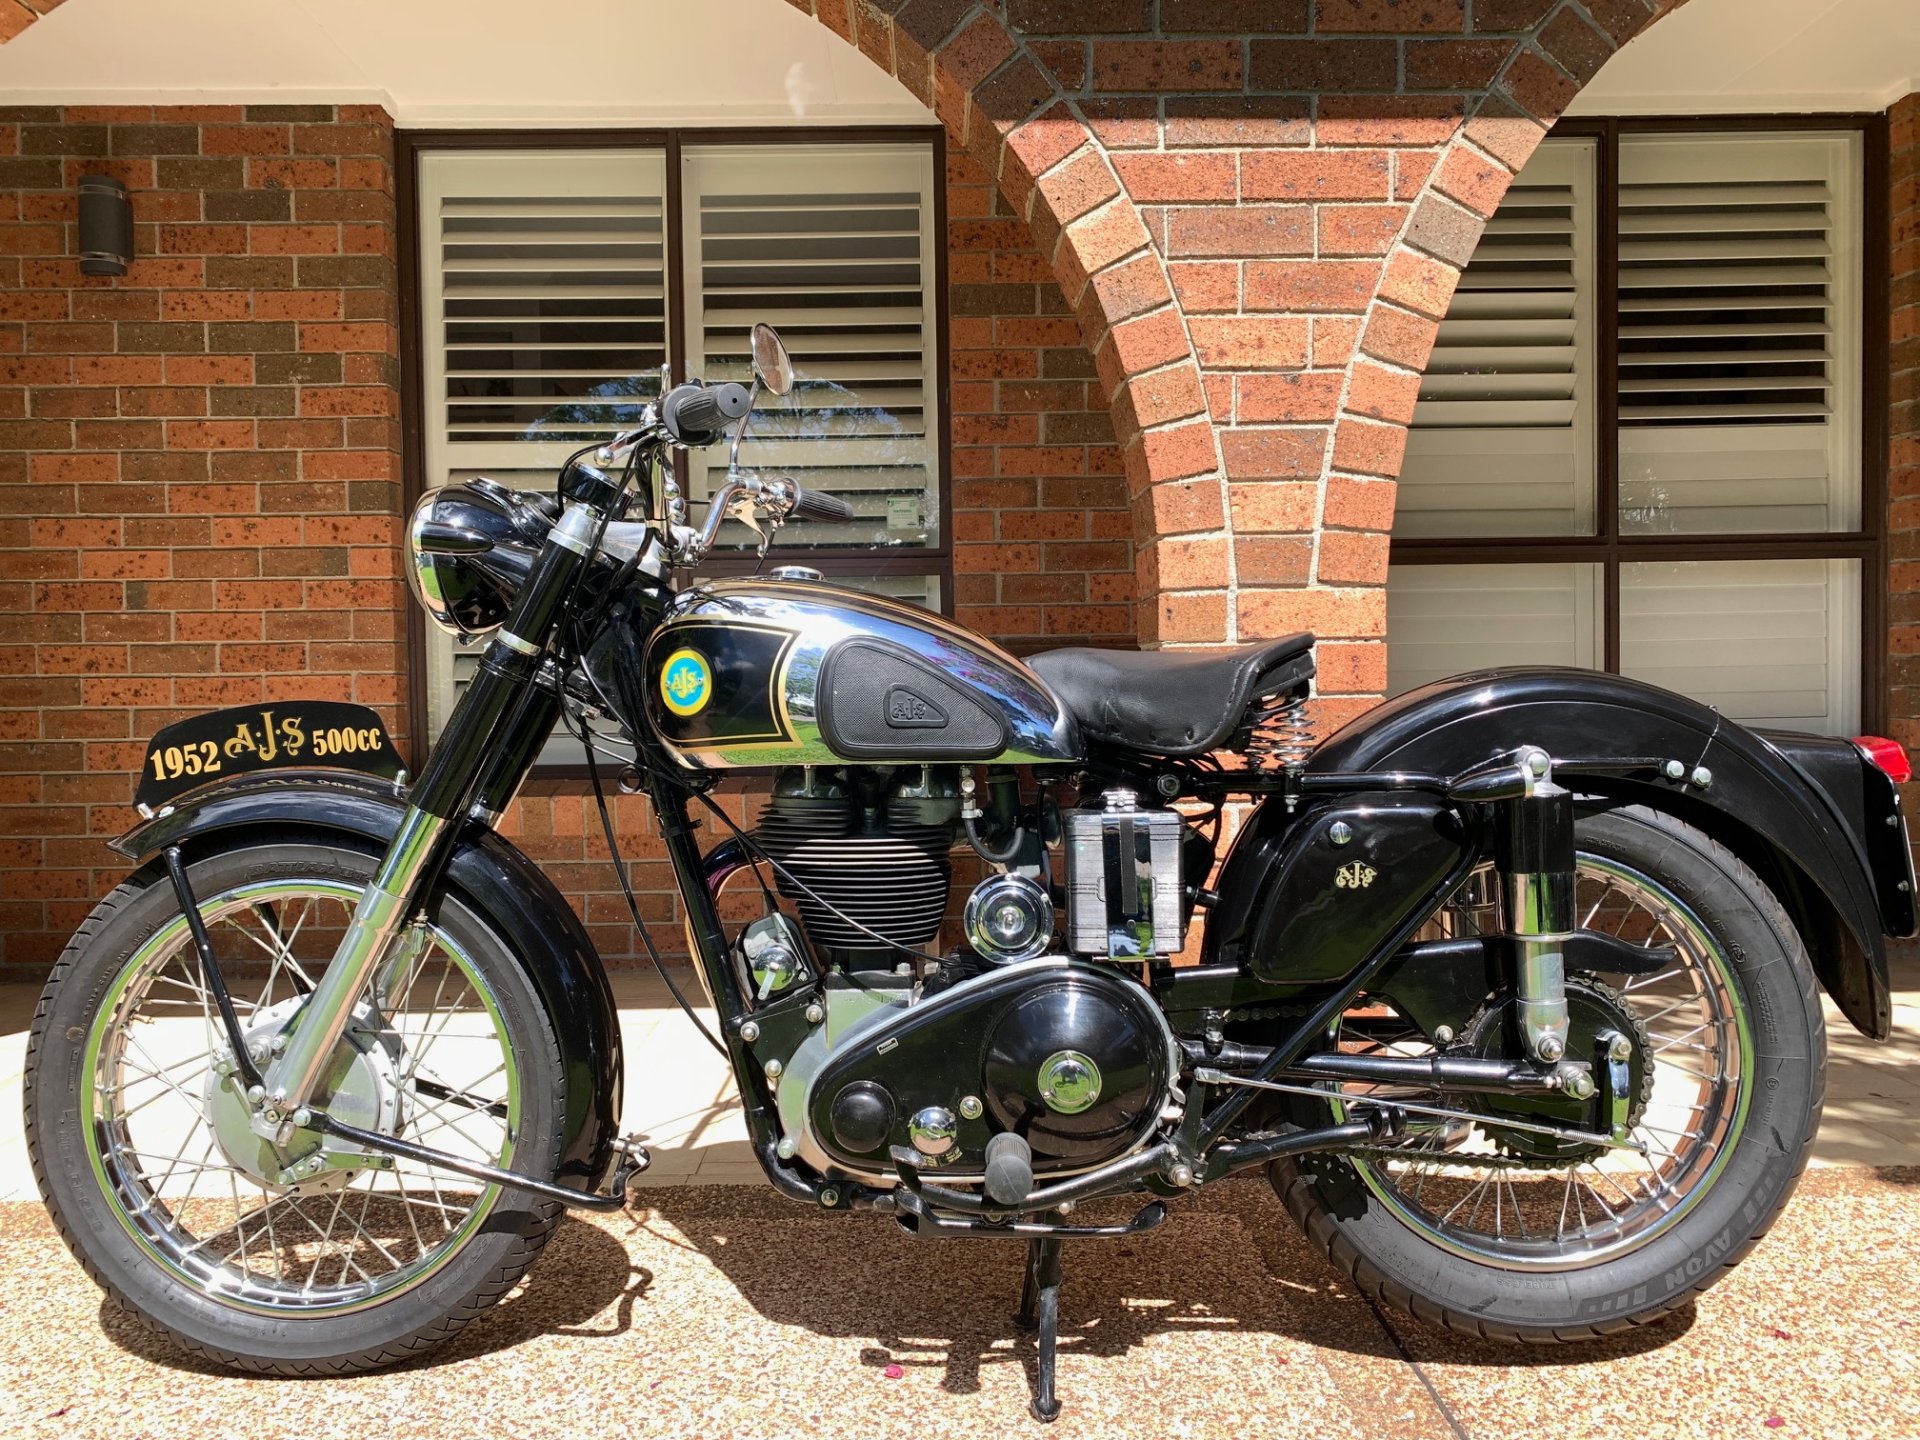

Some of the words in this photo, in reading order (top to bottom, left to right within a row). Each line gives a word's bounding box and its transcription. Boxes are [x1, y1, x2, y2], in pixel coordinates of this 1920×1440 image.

[150, 741, 221, 781] 1952
[312, 727, 382, 756] 500cc
[1665, 1228, 1734, 1291] AVON
